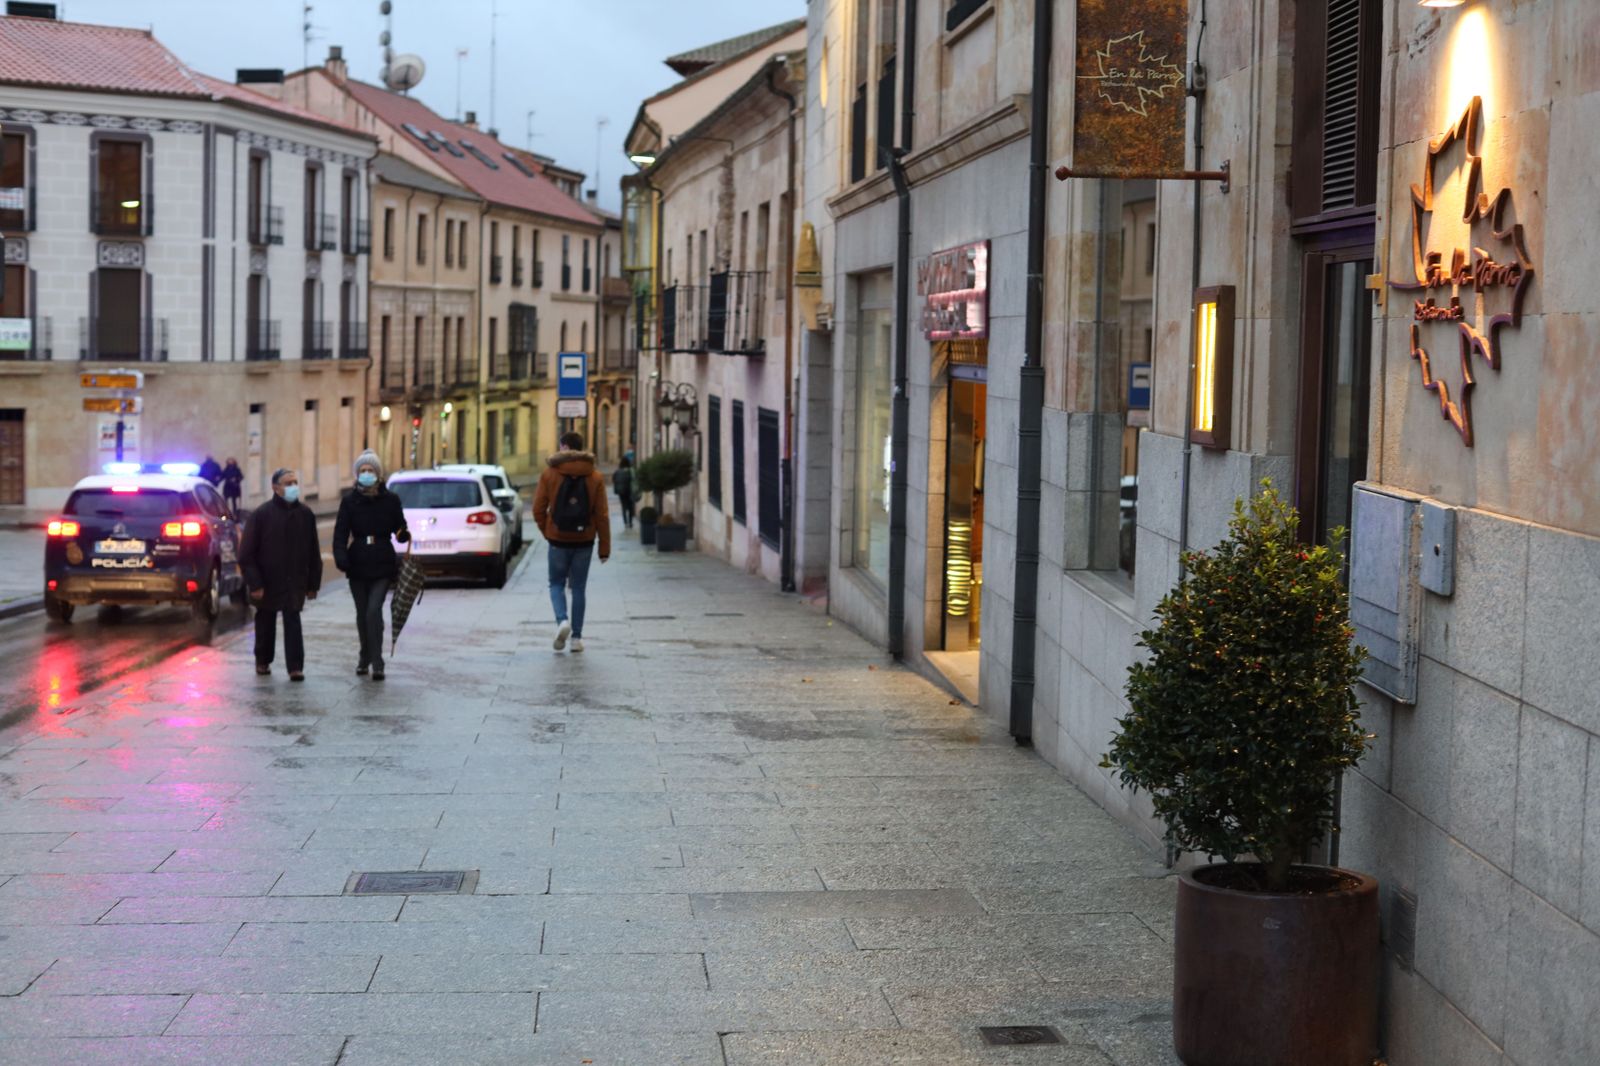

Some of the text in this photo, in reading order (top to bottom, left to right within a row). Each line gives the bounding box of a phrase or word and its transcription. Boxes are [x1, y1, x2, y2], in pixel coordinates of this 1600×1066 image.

[1109, 67, 1127, 78] En
[1146, 68, 1178, 81] Parra
[1425, 251, 1449, 288] En
[1473, 247, 1521, 293] Parra
